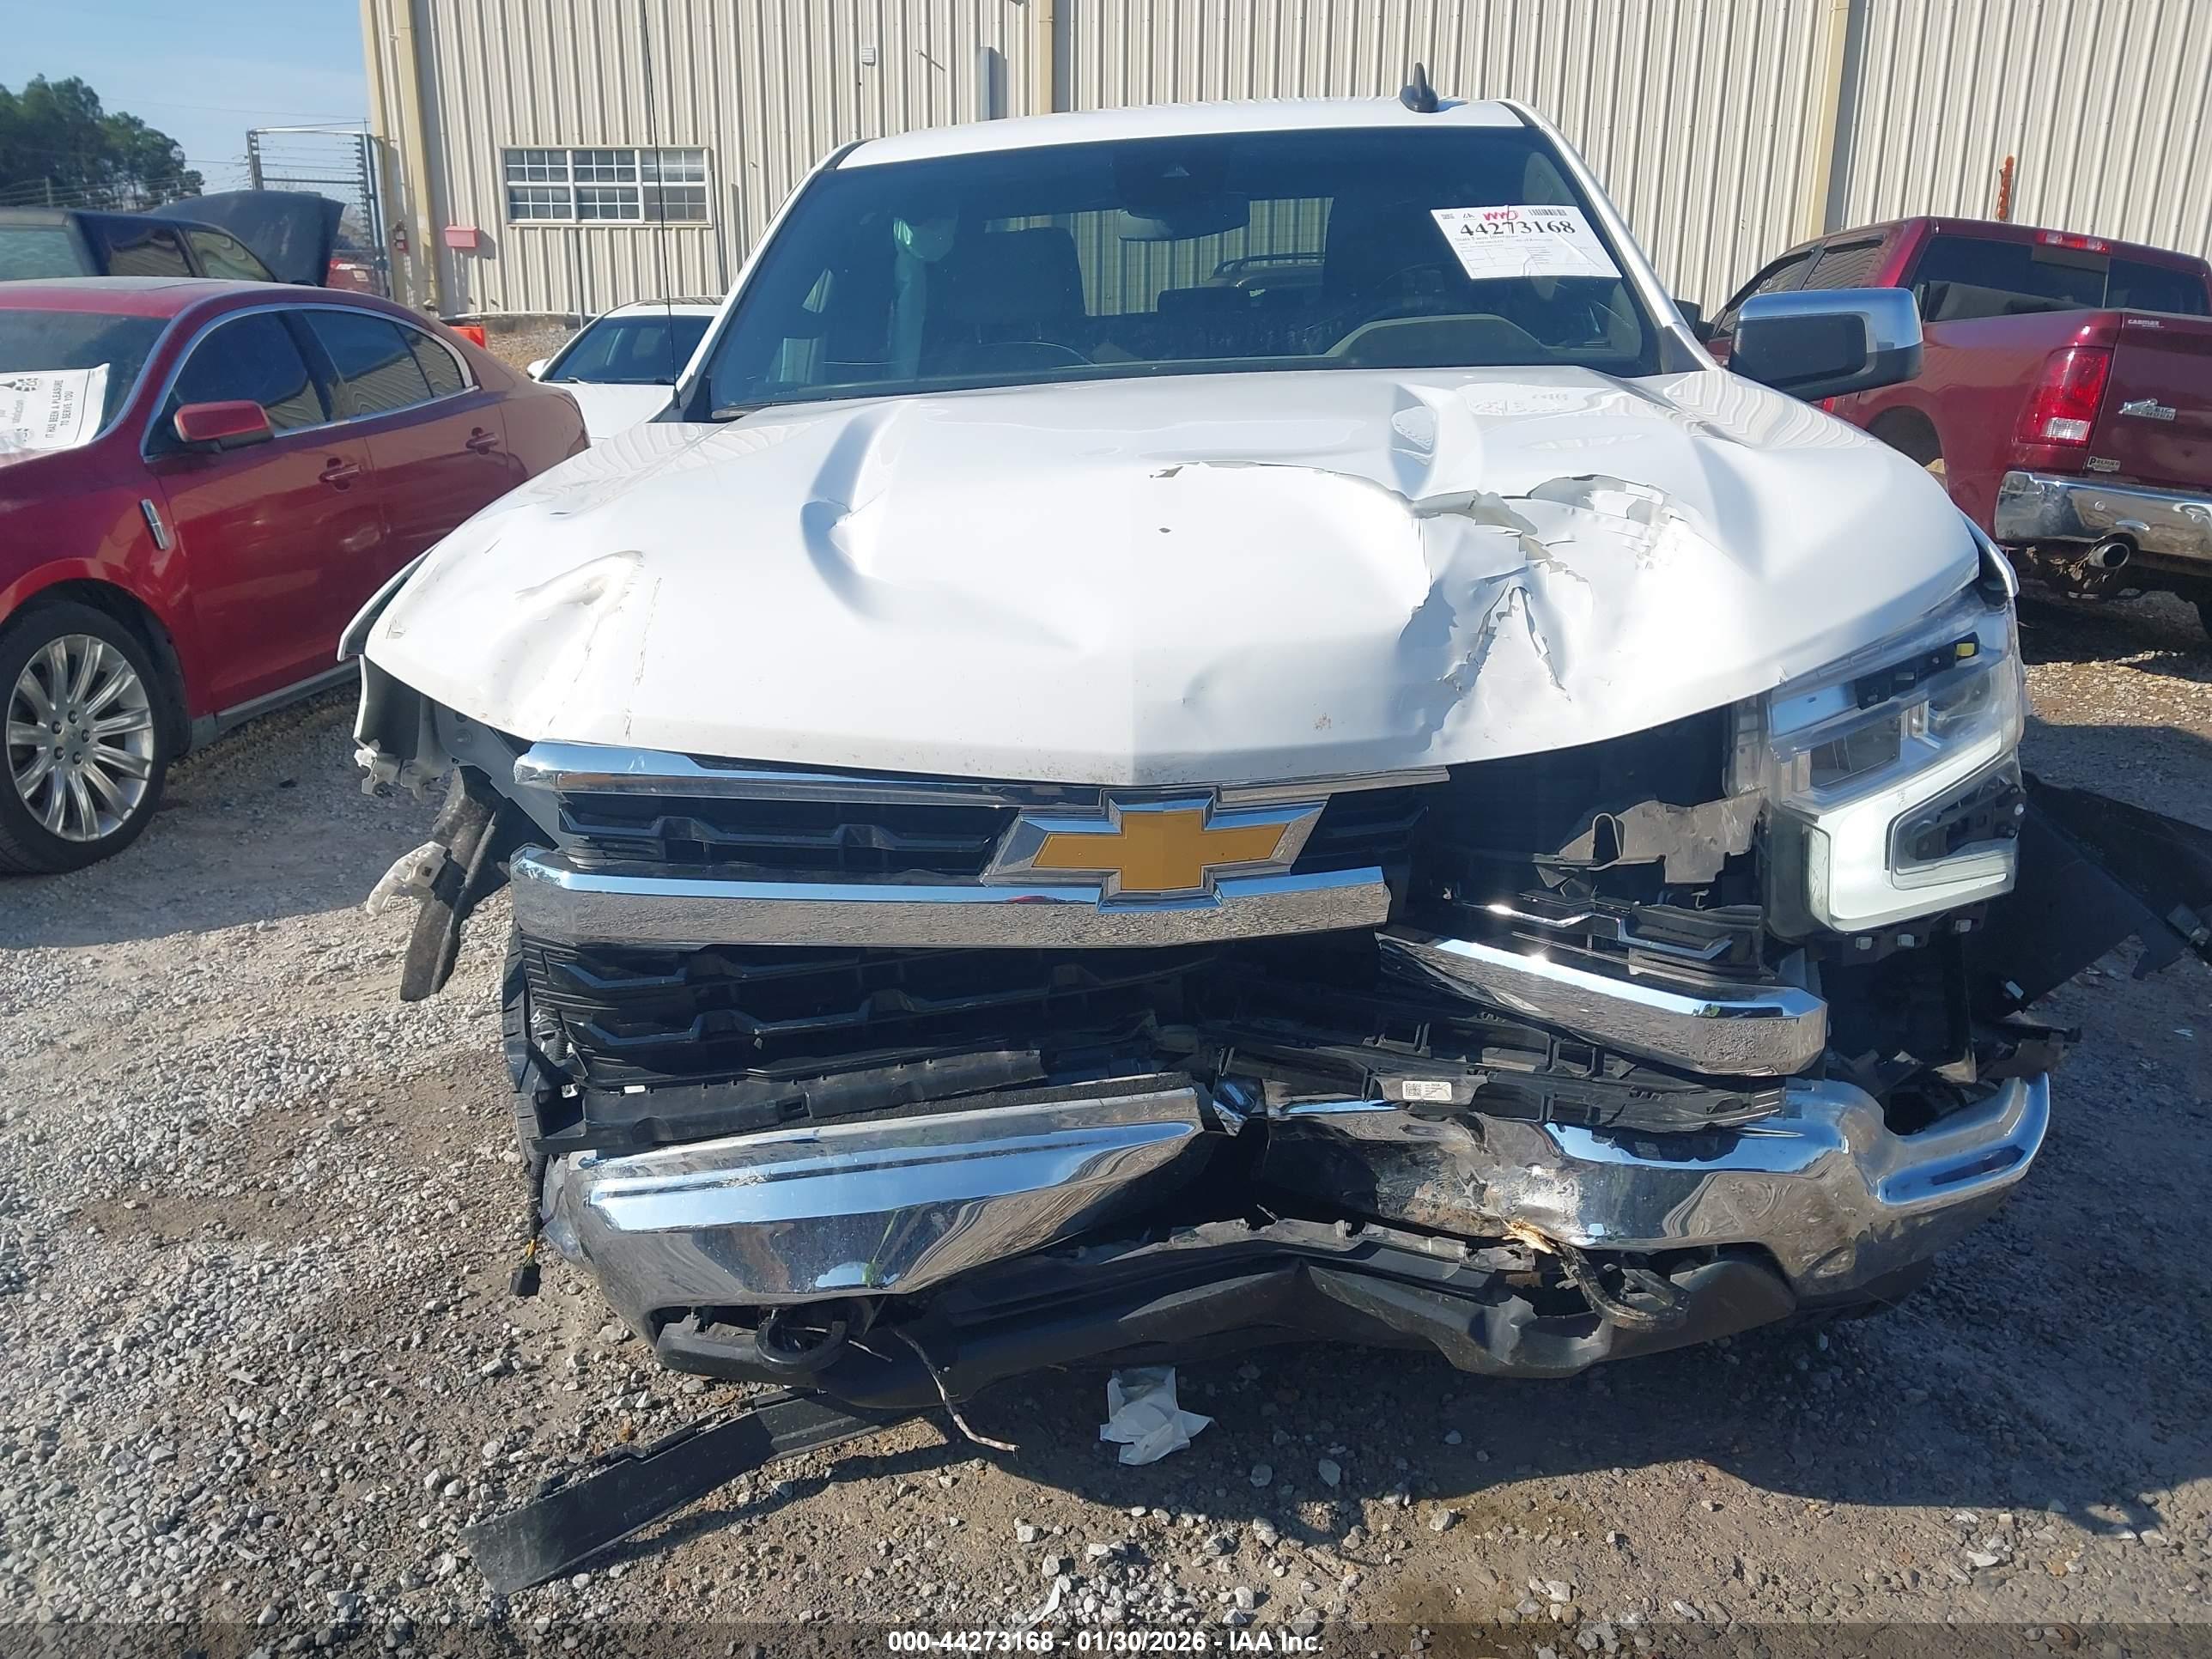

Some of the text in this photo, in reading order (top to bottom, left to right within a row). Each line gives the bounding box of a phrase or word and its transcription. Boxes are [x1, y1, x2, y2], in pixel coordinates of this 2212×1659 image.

[1460, 220, 1577, 236] 44273168
[52, 379, 64, 404] PLEASURE
[64, 391, 74, 401] YOU
[48, 410, 59, 422] BEEN
[62, 403, 73, 419] SERVE
[47, 423, 57, 433] HAS
